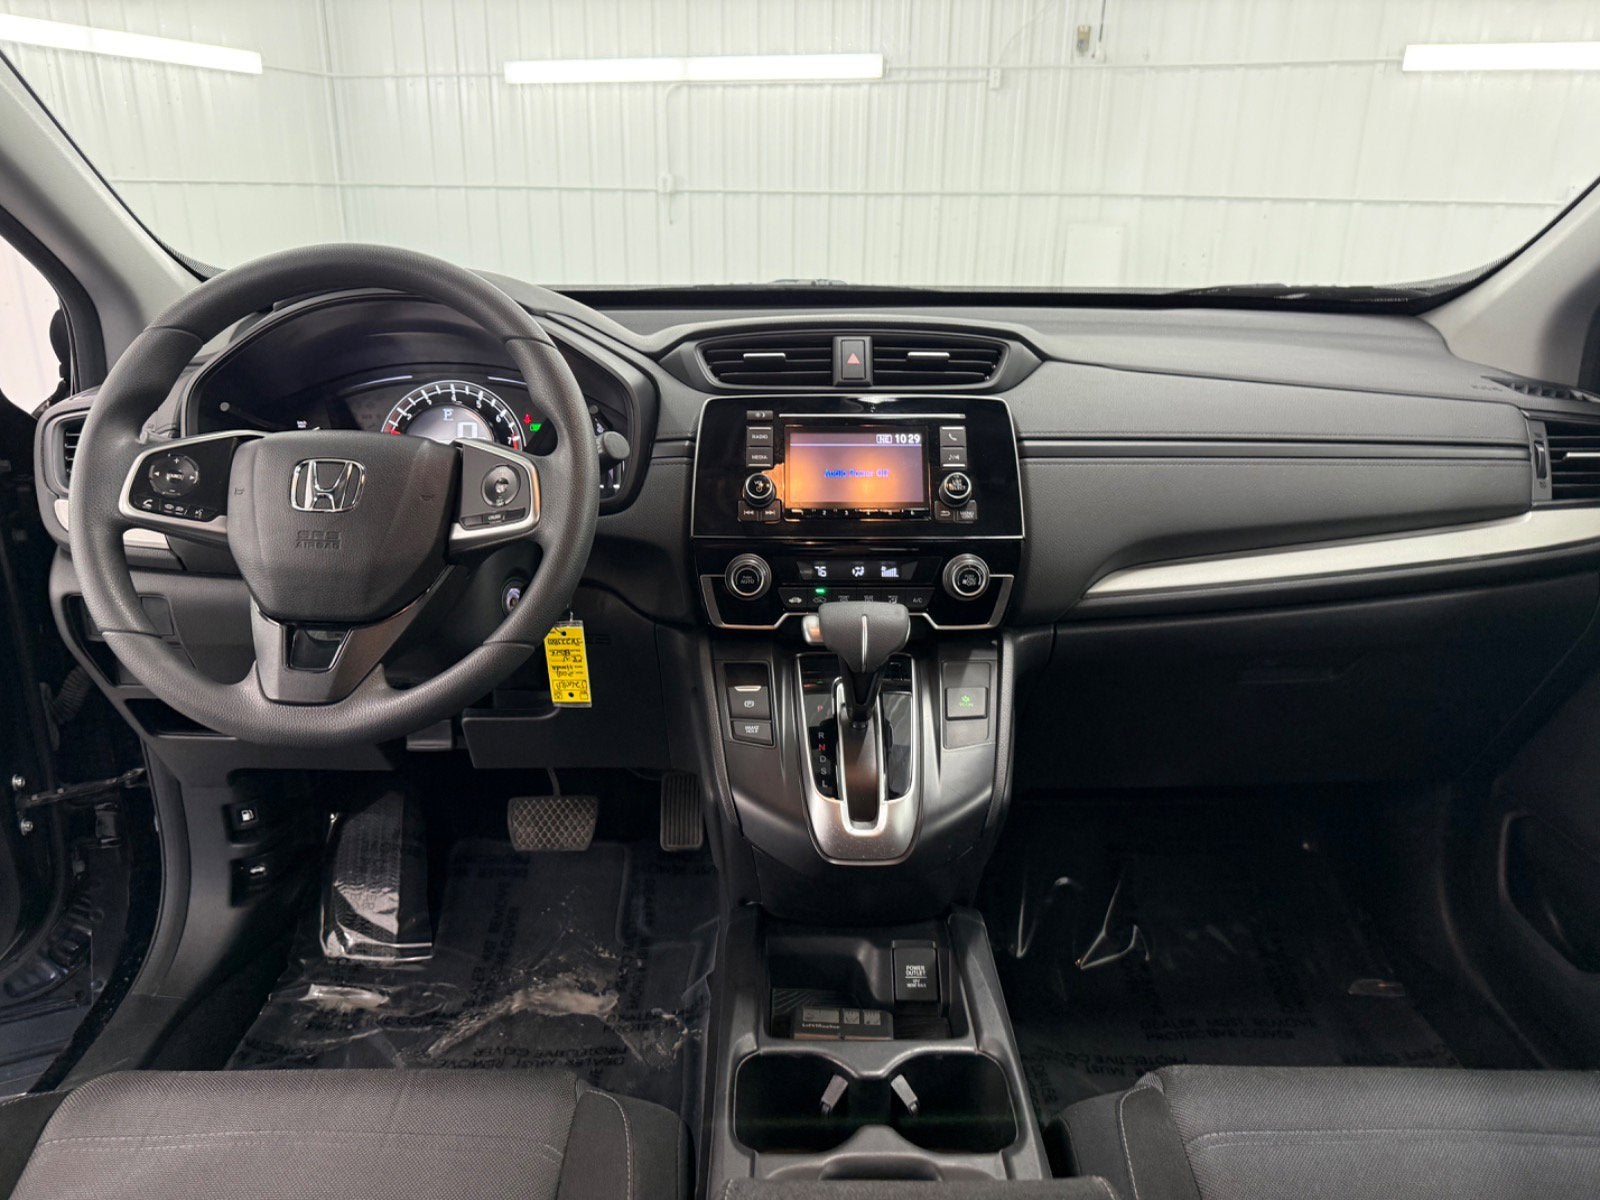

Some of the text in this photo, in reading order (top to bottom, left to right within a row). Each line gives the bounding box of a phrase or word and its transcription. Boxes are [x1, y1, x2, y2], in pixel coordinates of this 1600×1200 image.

[442, 408, 454, 421] P
[819, 755, 827, 763] D
[820, 767, 827, 775] S
[821, 780, 828, 788] L
